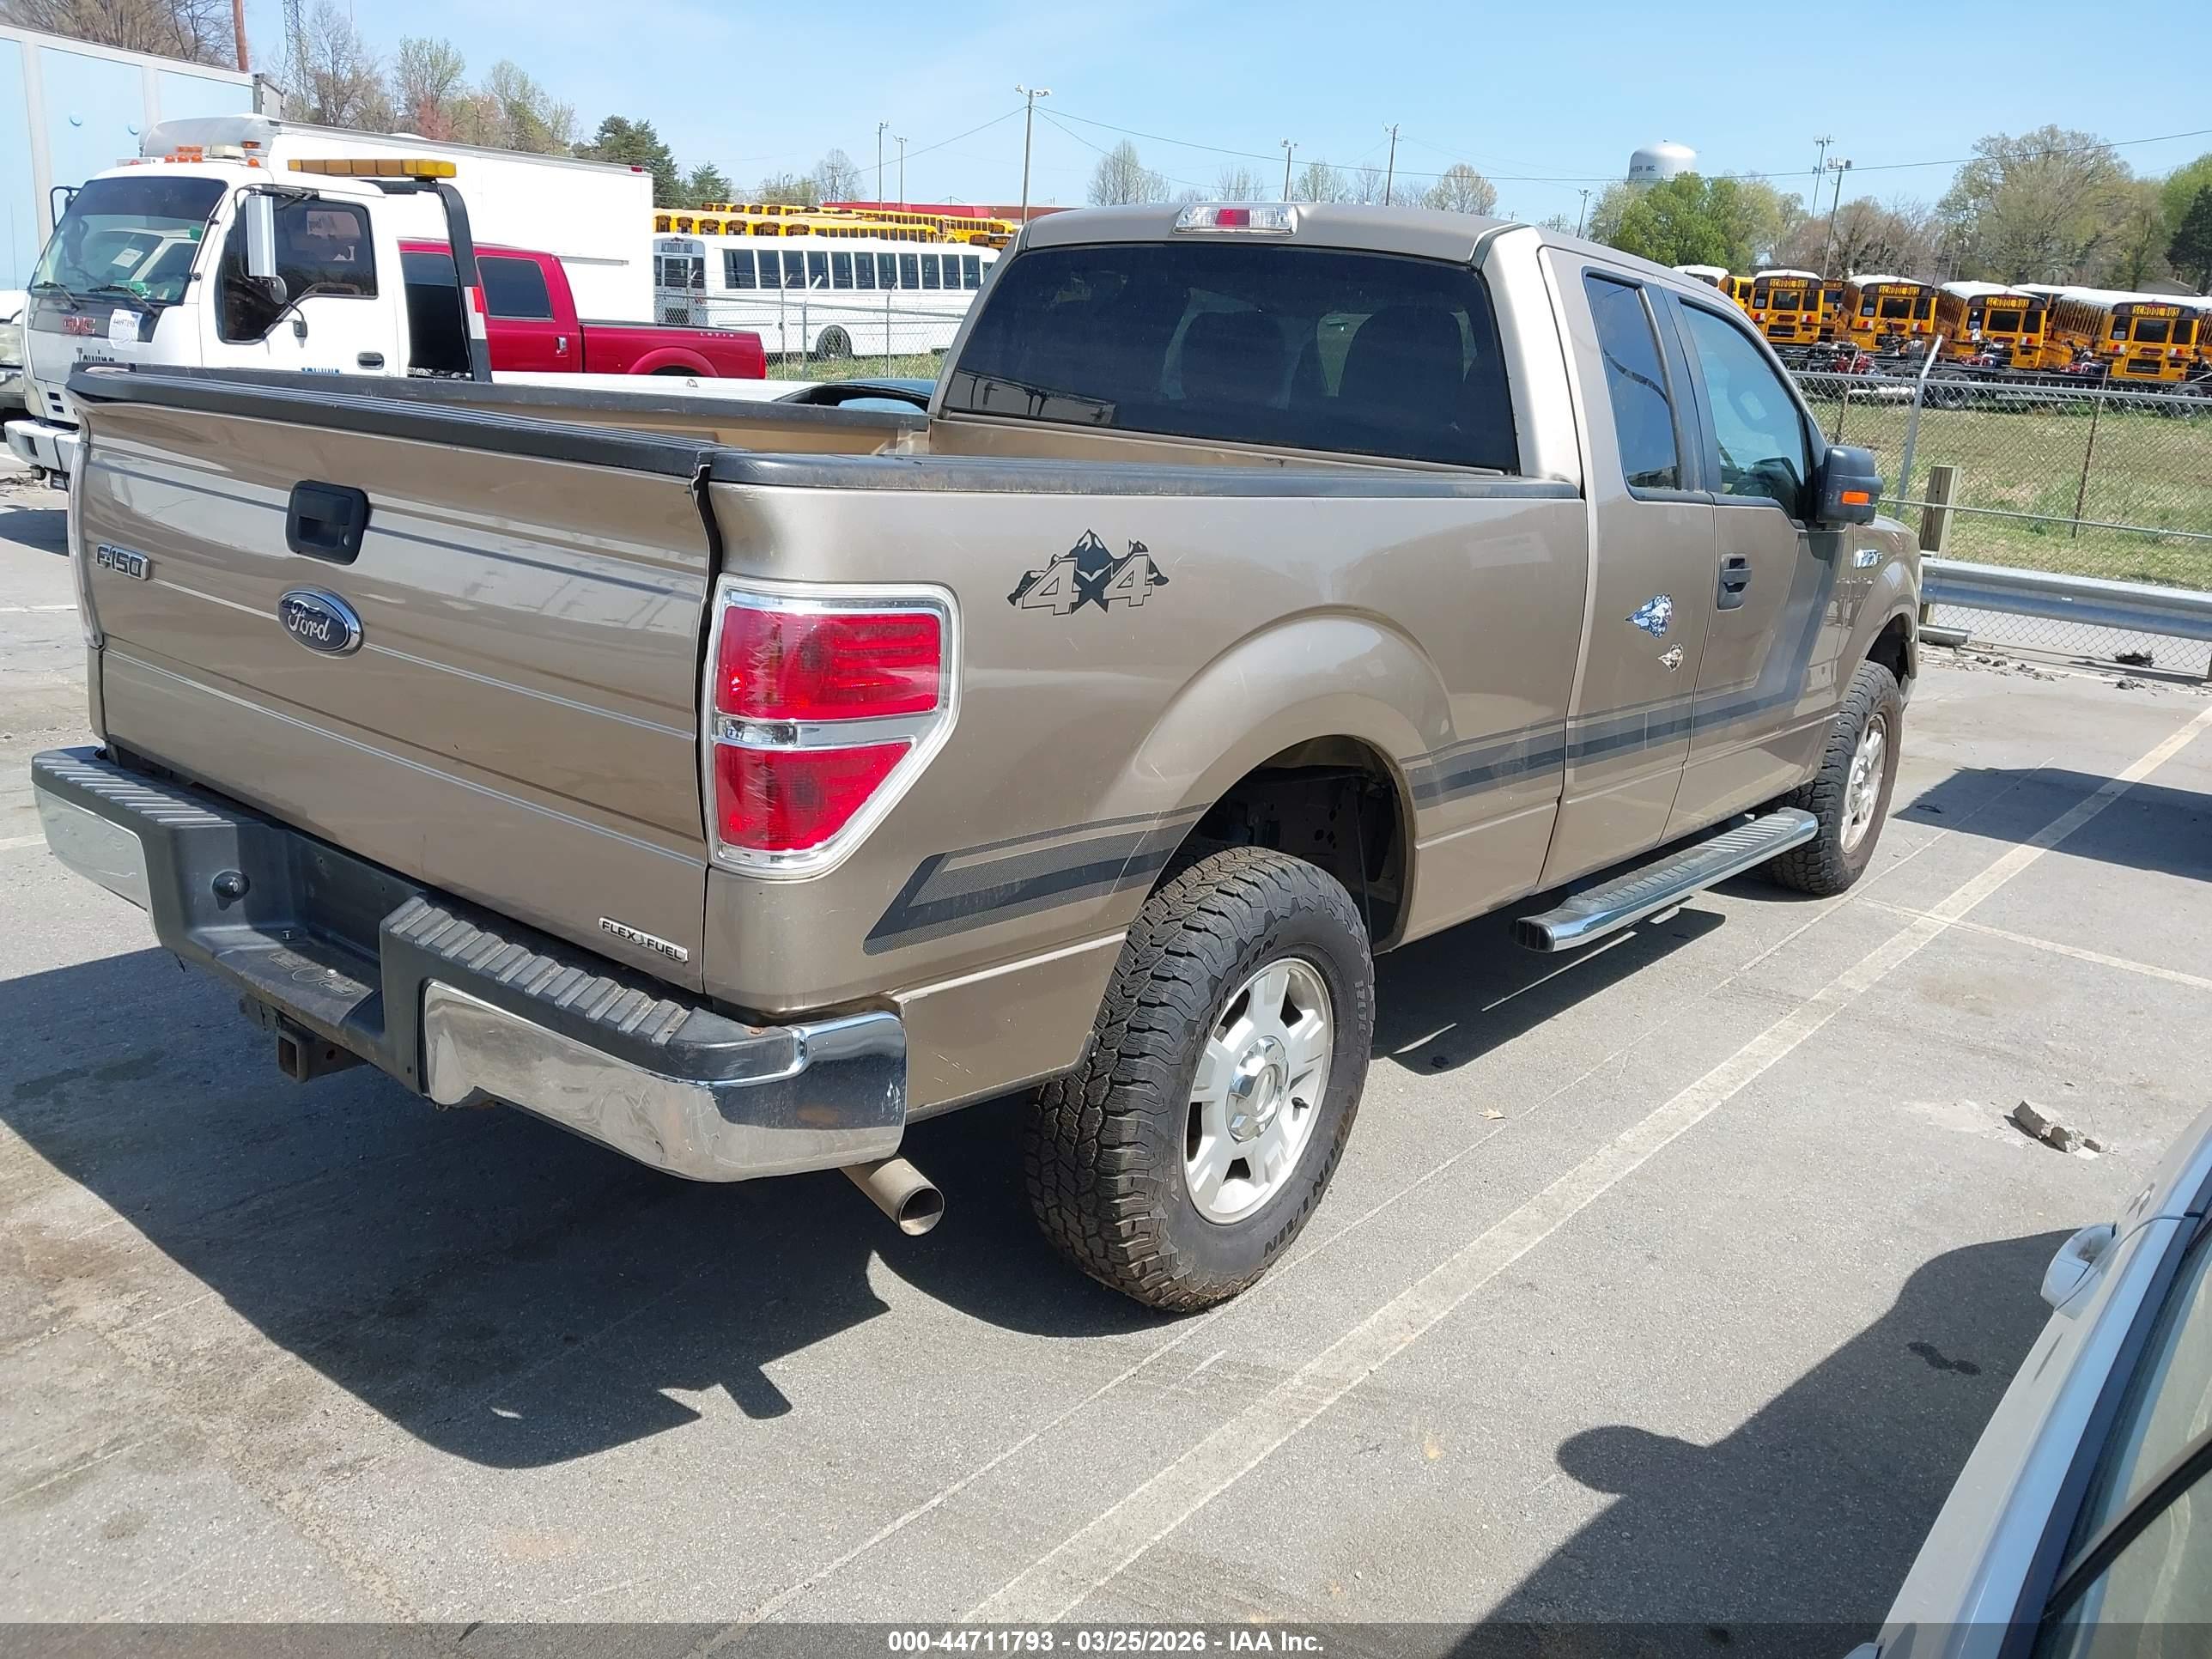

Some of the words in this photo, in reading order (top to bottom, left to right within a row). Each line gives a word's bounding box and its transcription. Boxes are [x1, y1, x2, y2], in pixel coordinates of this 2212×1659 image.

[1771, 279, 1792, 288] SCHOOL
[1796, 280, 1808, 289] BUS
[1880, 285, 1902, 295] SCHOOL
[1906, 287, 1919, 296] BUS
[1987, 297, 2011, 307] SCHOOL
[2015, 299, 2028, 308] BUS
[2134, 306, 2159, 316] SCHOOL
[2165, 307, 2179, 317] BUS
[64, 316, 96, 334] GMC
[287, 600, 331, 641] Ford
[602, 921, 636, 942] FLEX
[647, 938, 683, 960] FUEL
